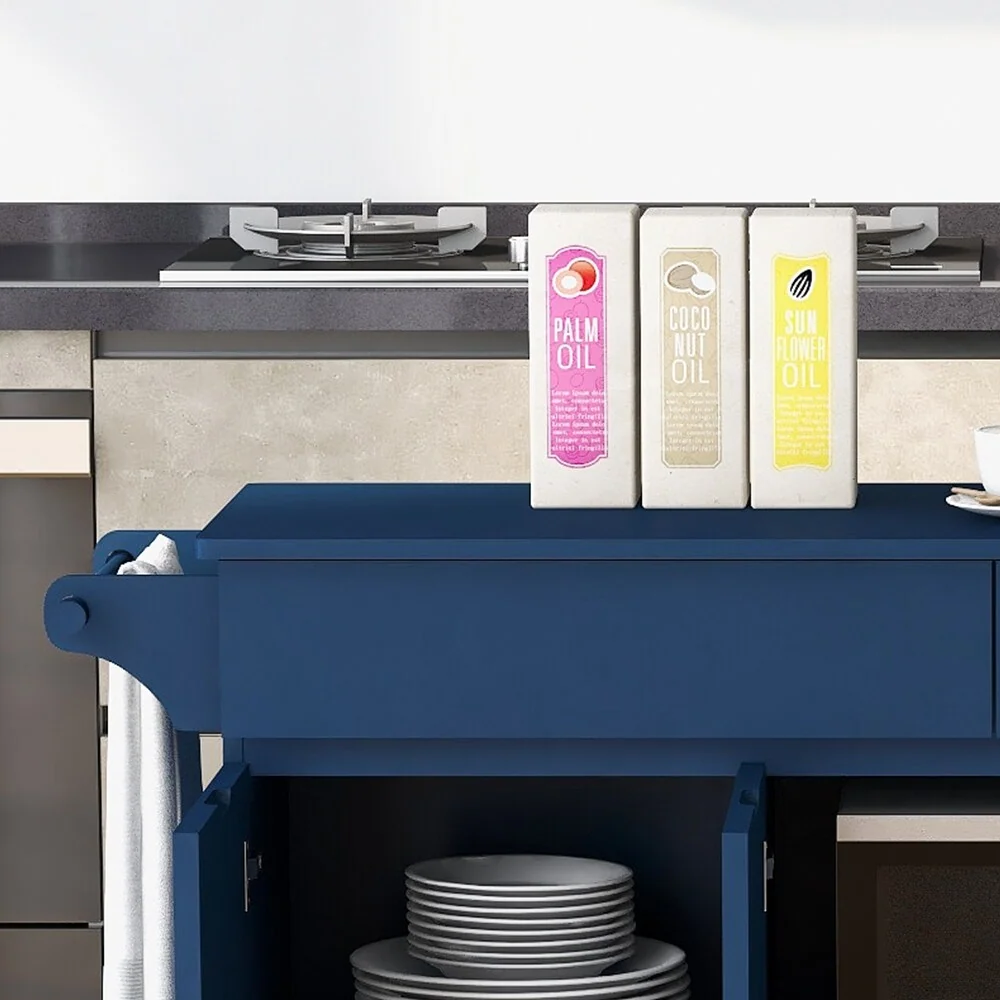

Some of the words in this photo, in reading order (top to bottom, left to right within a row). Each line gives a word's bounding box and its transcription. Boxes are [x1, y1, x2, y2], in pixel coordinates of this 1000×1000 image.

[554, 317, 599, 342] PALM
[669, 306, 710, 331] COCO
[785, 310, 817, 334] SUN
[557, 344, 596, 369] OIL
[675, 333, 706, 357] NUT
[777, 336, 825, 361] FLOWER
[672, 359, 710, 384] OIL
[782, 362, 821, 388] OIL
